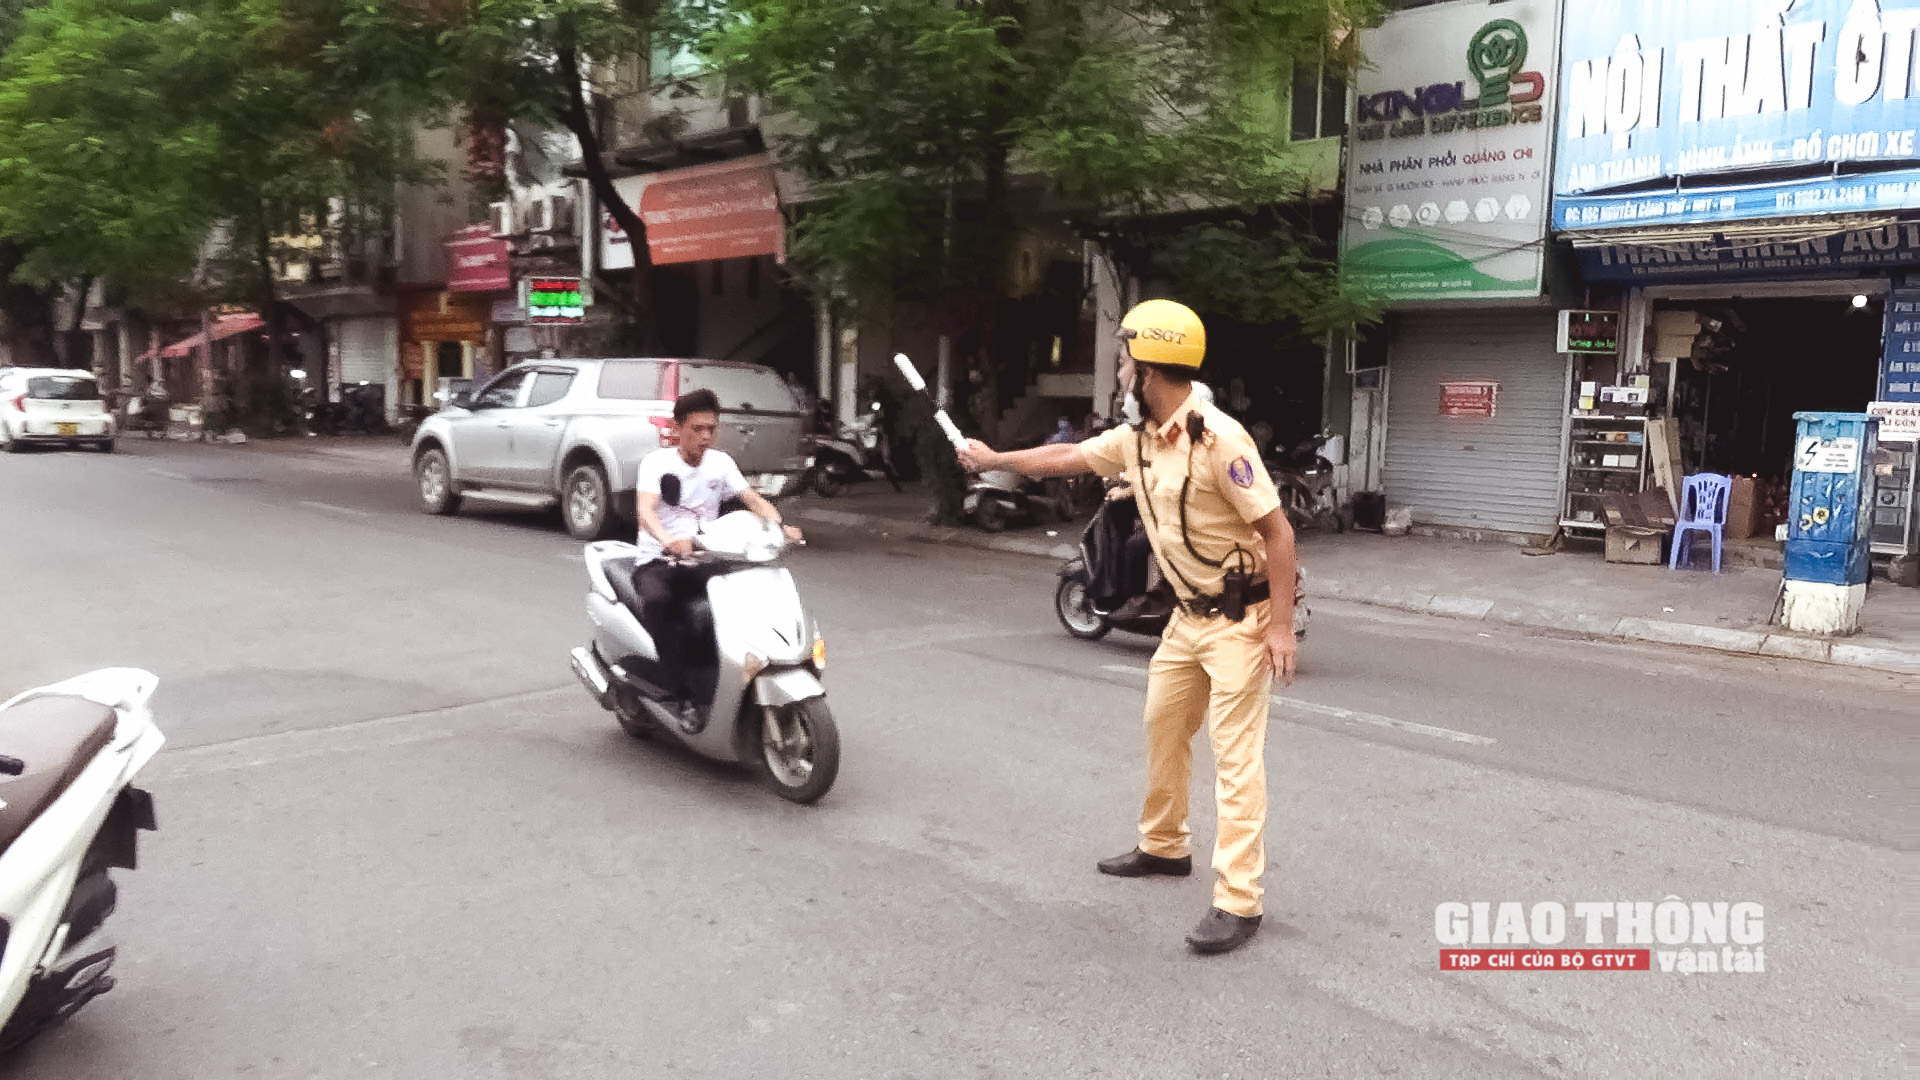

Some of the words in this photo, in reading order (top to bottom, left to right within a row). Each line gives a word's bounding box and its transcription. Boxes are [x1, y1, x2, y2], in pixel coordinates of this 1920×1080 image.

[1567, 33, 1665, 150] NỘI
[1676, 0, 1827, 123] THẤT
[1601, 154, 1661, 186] THANH
[1885, 129, 1916, 156] XE
[1141, 327, 1187, 345] CSGT
